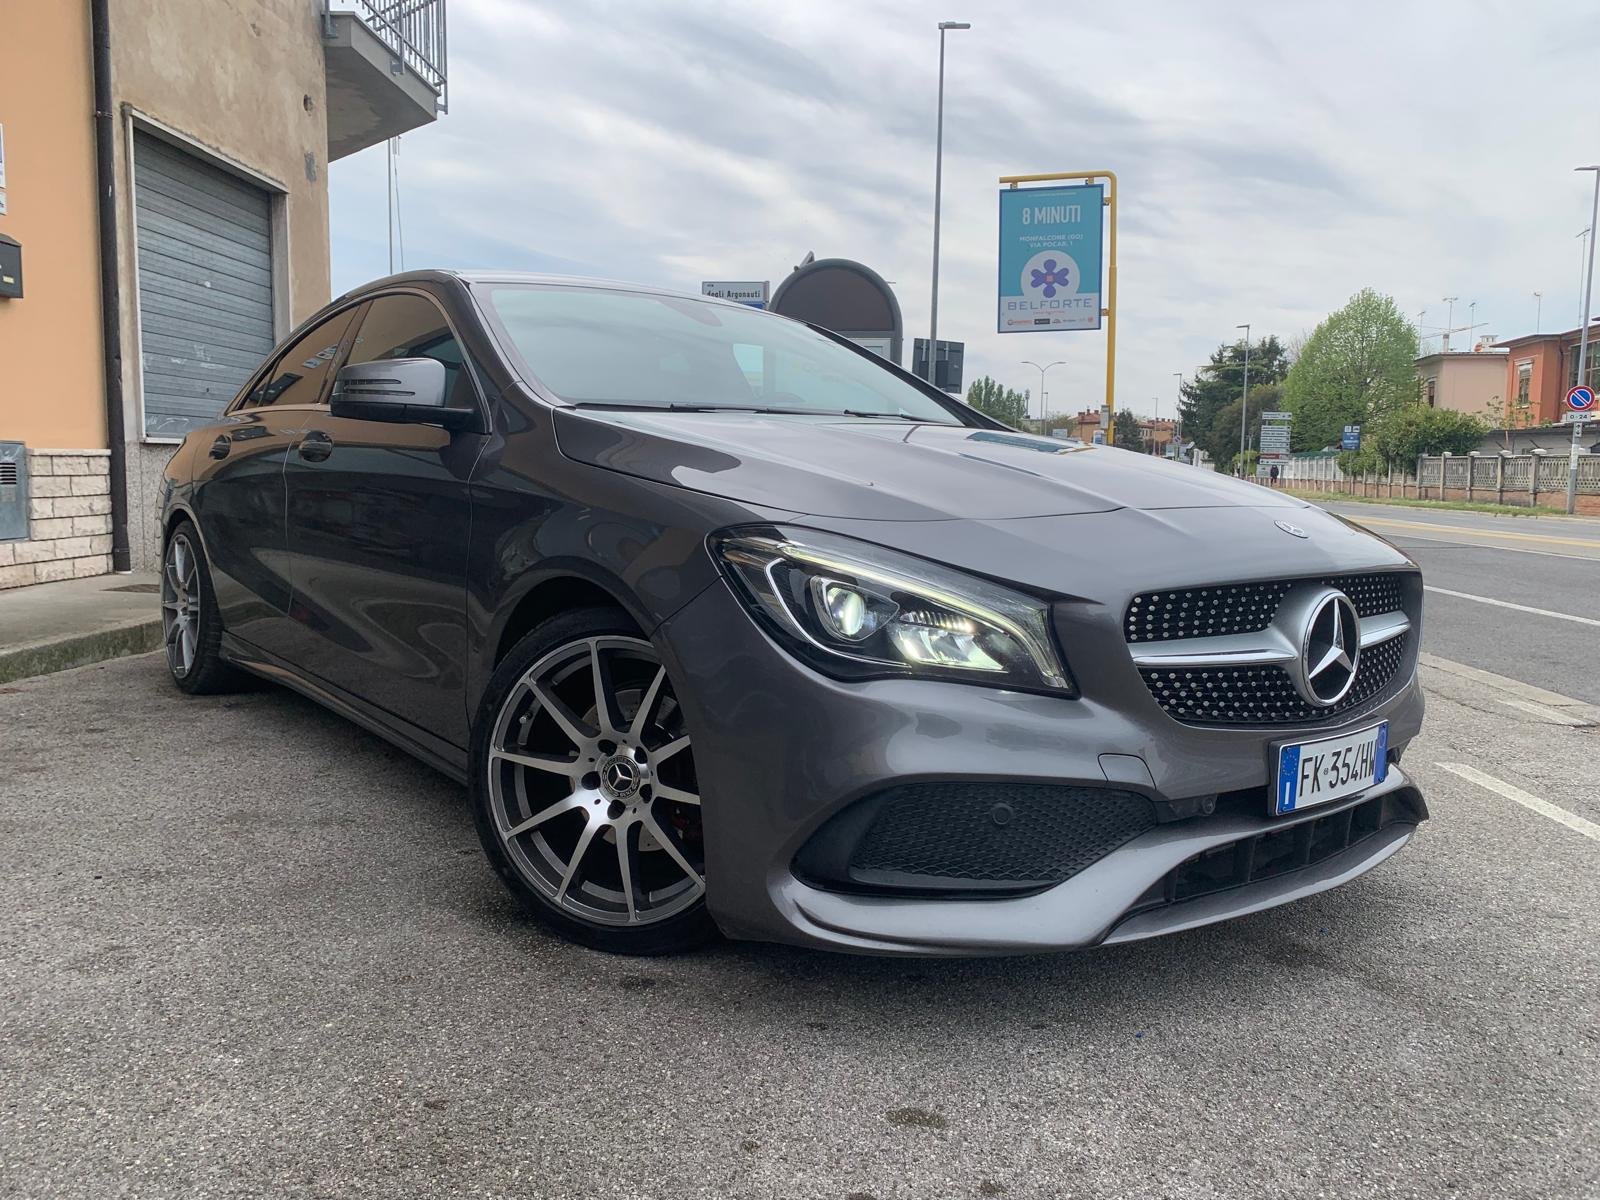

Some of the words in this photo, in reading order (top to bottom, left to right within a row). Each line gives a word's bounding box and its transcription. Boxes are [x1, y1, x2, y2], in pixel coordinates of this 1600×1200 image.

[1022, 207, 1031, 225] 8
[1034, 204, 1081, 225] MINUTI
[727, 290, 761, 300] Argonauti
[1007, 298, 1092, 311] BELFORTE
[1299, 754, 1325, 797] FK
